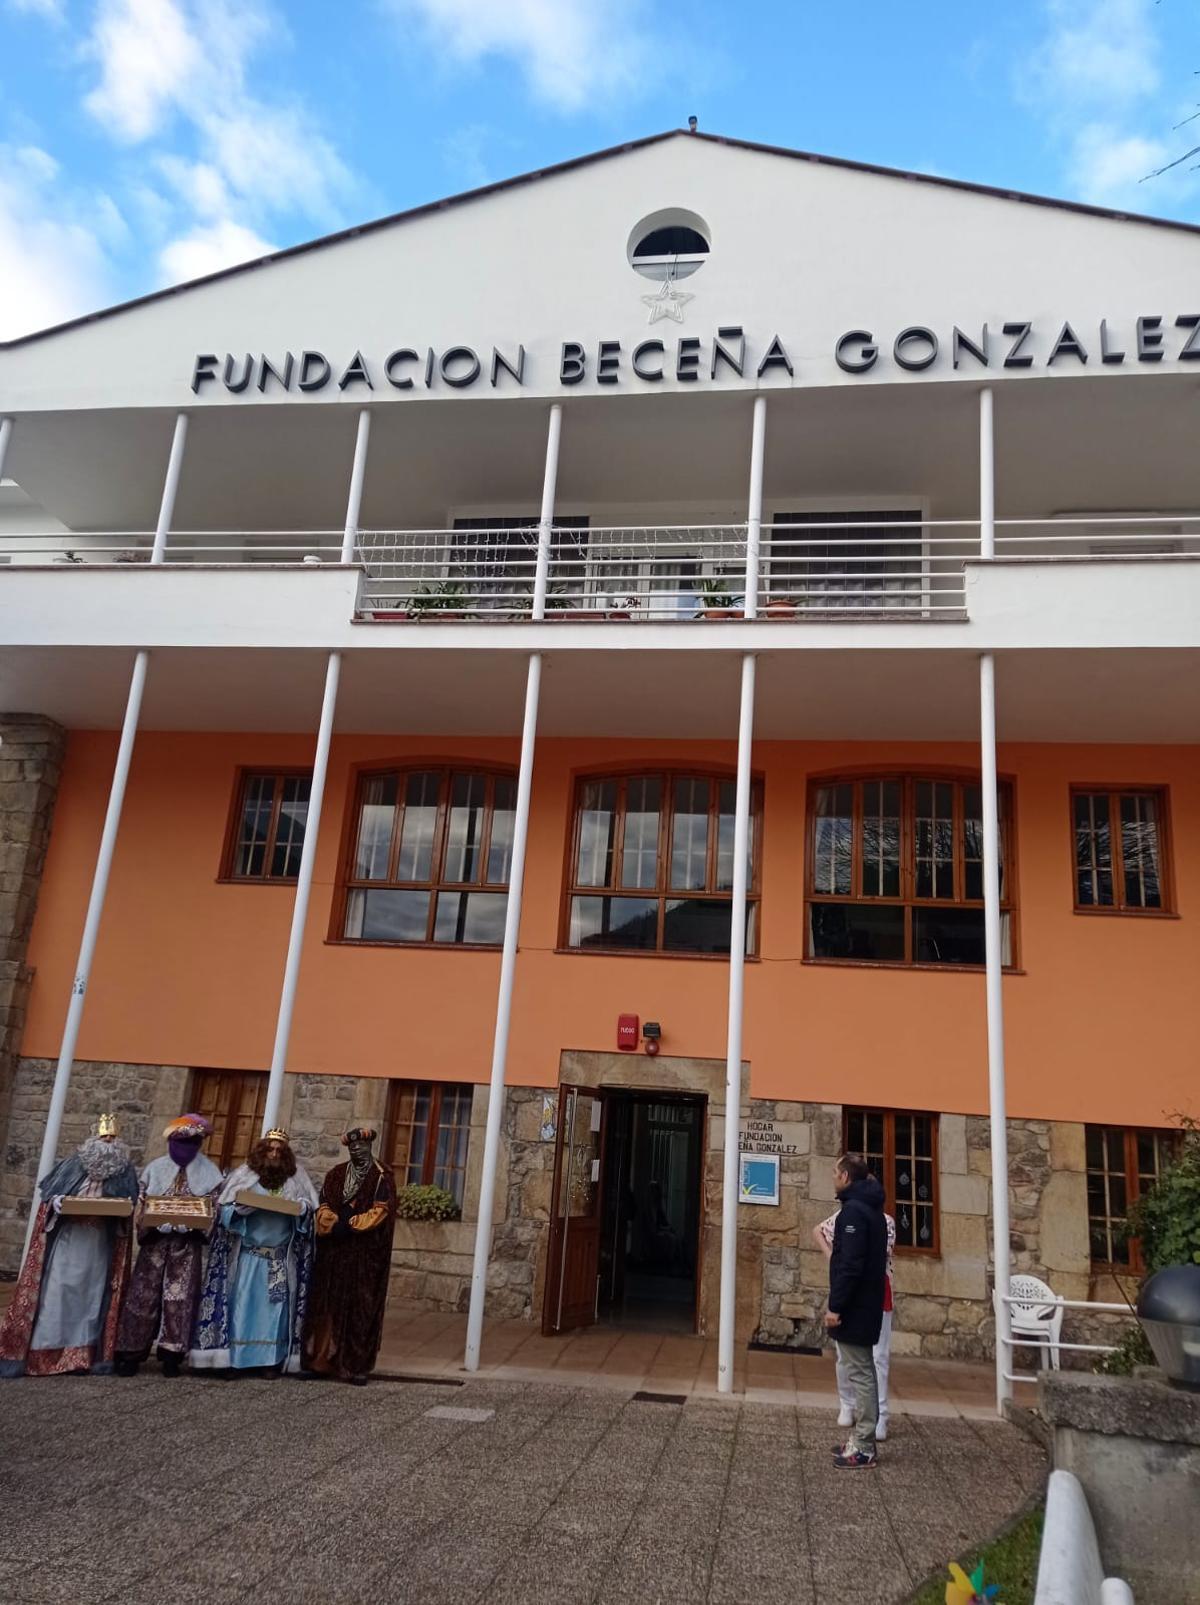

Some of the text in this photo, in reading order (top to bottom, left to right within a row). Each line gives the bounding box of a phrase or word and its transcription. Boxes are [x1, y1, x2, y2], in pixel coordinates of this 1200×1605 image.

[191, 314, 1200, 393] FUNDACION BECEÑA GONZALEZ
